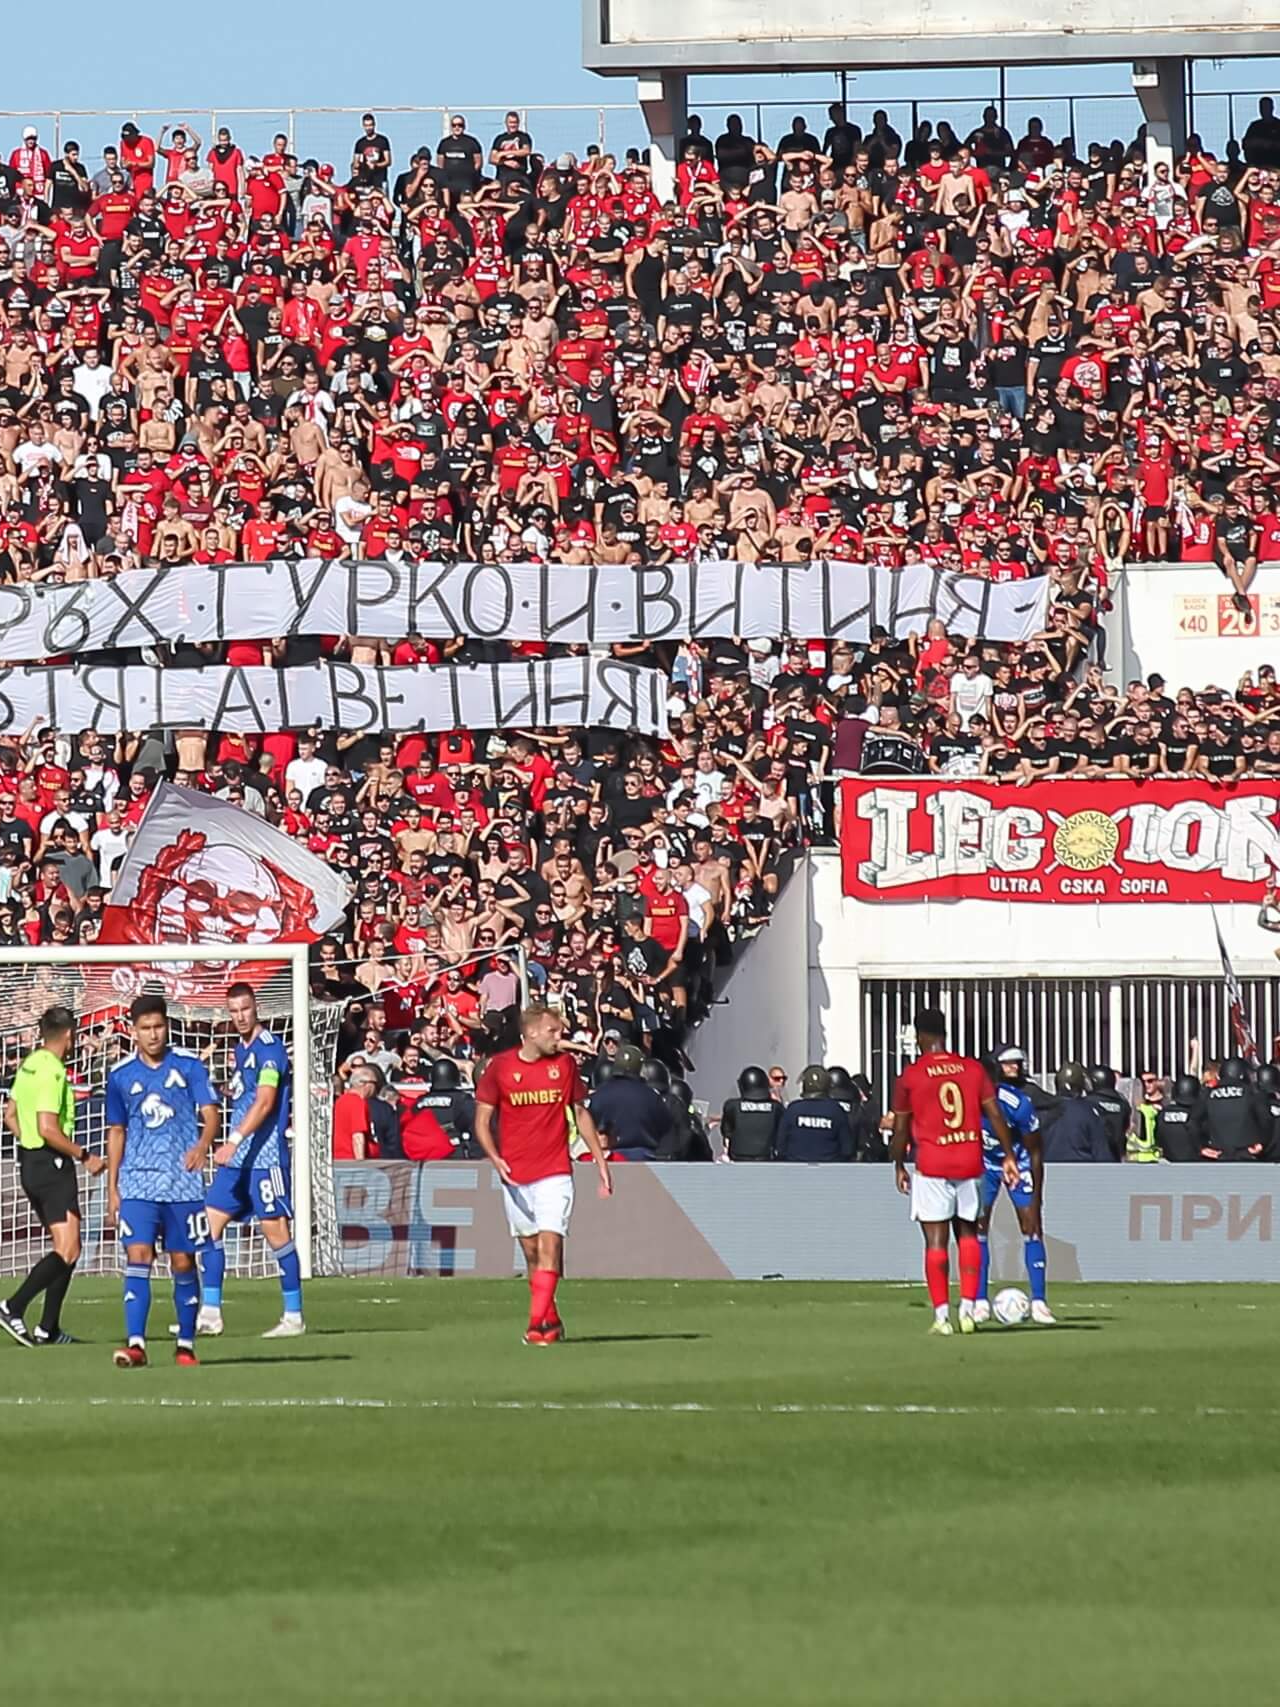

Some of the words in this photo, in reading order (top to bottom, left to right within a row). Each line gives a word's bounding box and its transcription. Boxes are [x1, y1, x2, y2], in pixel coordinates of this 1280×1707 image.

[209, 560, 513, 638] ГУРКО
[539, 563, 599, 641] И
[1187, 615, 1208, 632] 40
[1221, 609, 1257, 635] 20
[989, 877, 1042, 893] ULTRA
[1060, 878, 1106, 894] CSKA
[1120, 878, 1169, 894] SOFIA
[927, 1063, 965, 1078] NAZON
[938, 1080, 964, 1129] 9
[798, 1116, 833, 1129] POLICE
[259, 1179, 275, 1204] 8
[186, 1211, 209, 1240] 10
[1129, 1193, 1273, 1242] ПРИ
